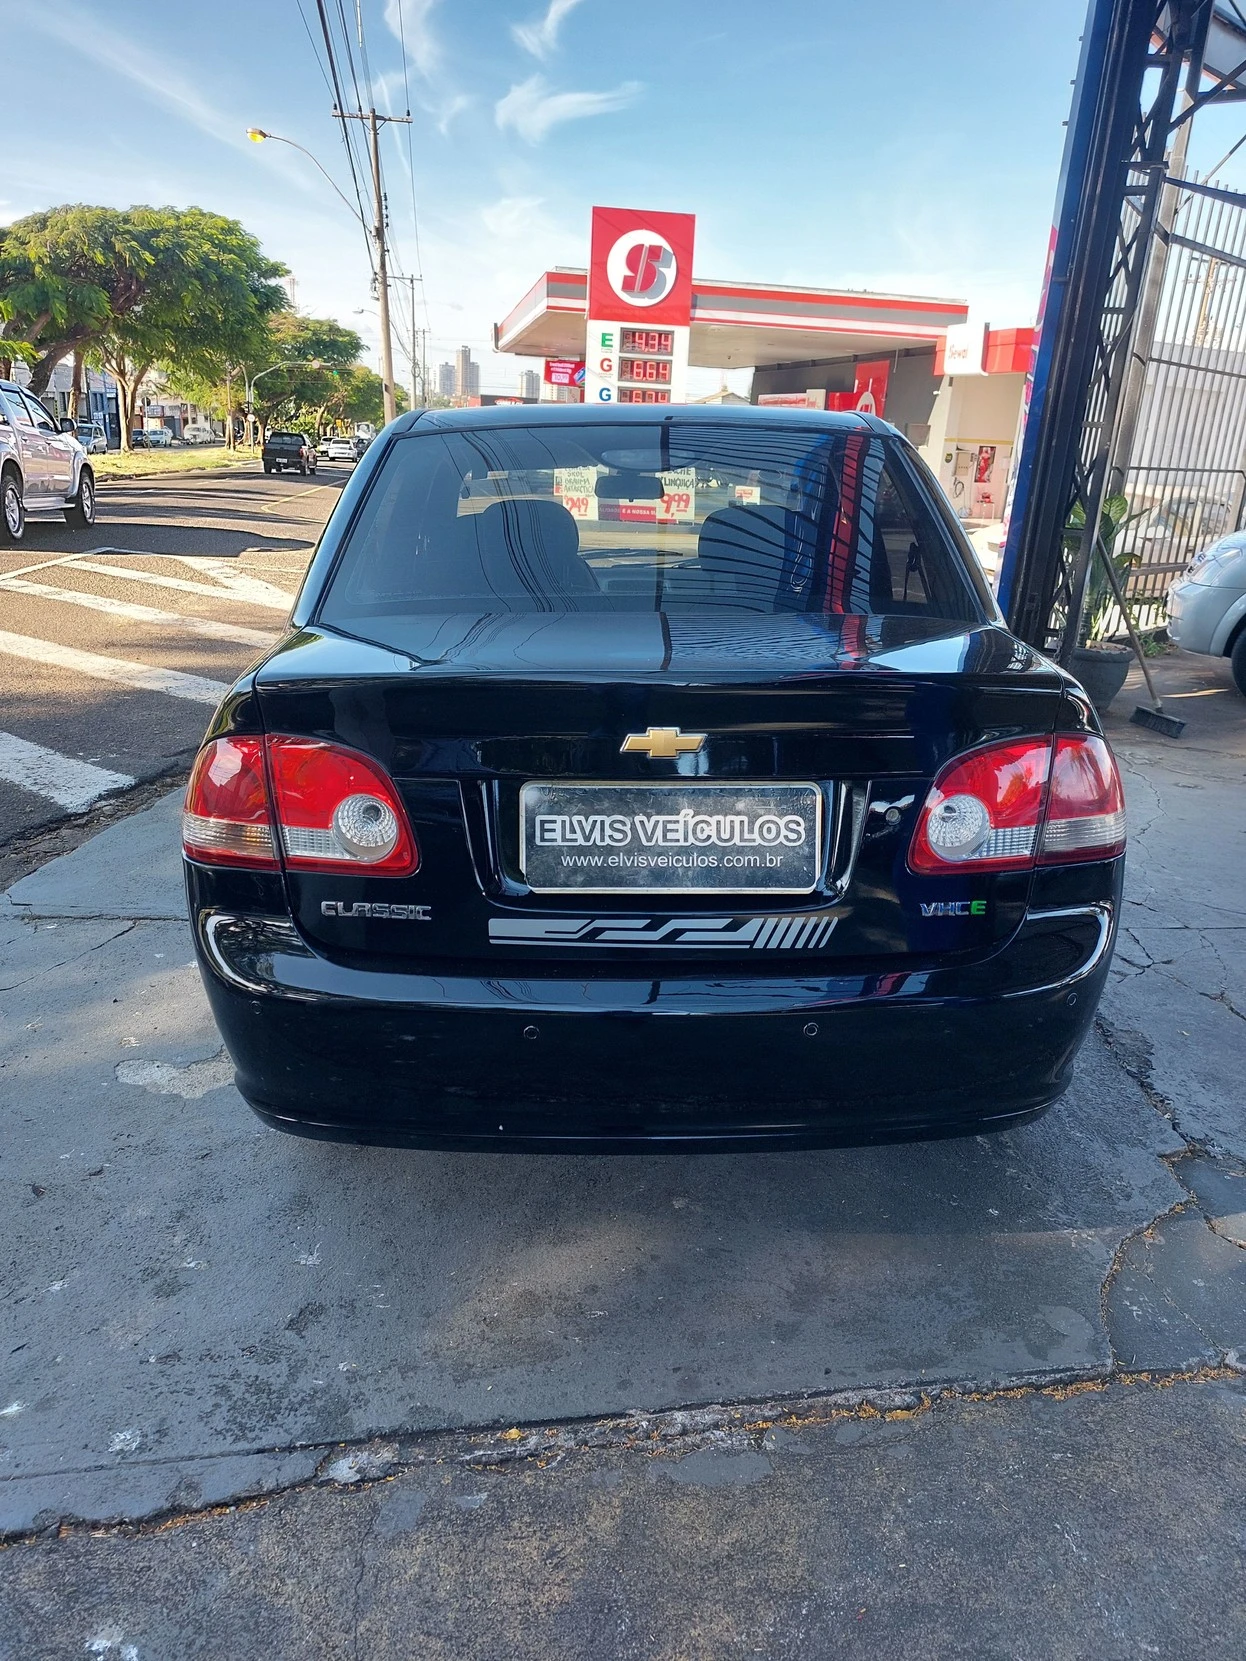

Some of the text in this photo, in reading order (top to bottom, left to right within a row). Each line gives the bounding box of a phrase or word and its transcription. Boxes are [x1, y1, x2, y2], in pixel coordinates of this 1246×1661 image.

[601, 332, 614, 348] E
[600, 357, 613, 372] G
[599, 387, 612, 402] G
[535, 809, 806, 847] ELVIS VEÍCULOS
[560, 852, 784, 867] www.elvisveiculos.com.br
[321, 900, 432, 921] CLASSIC
[920, 900, 987, 917] VHCE
